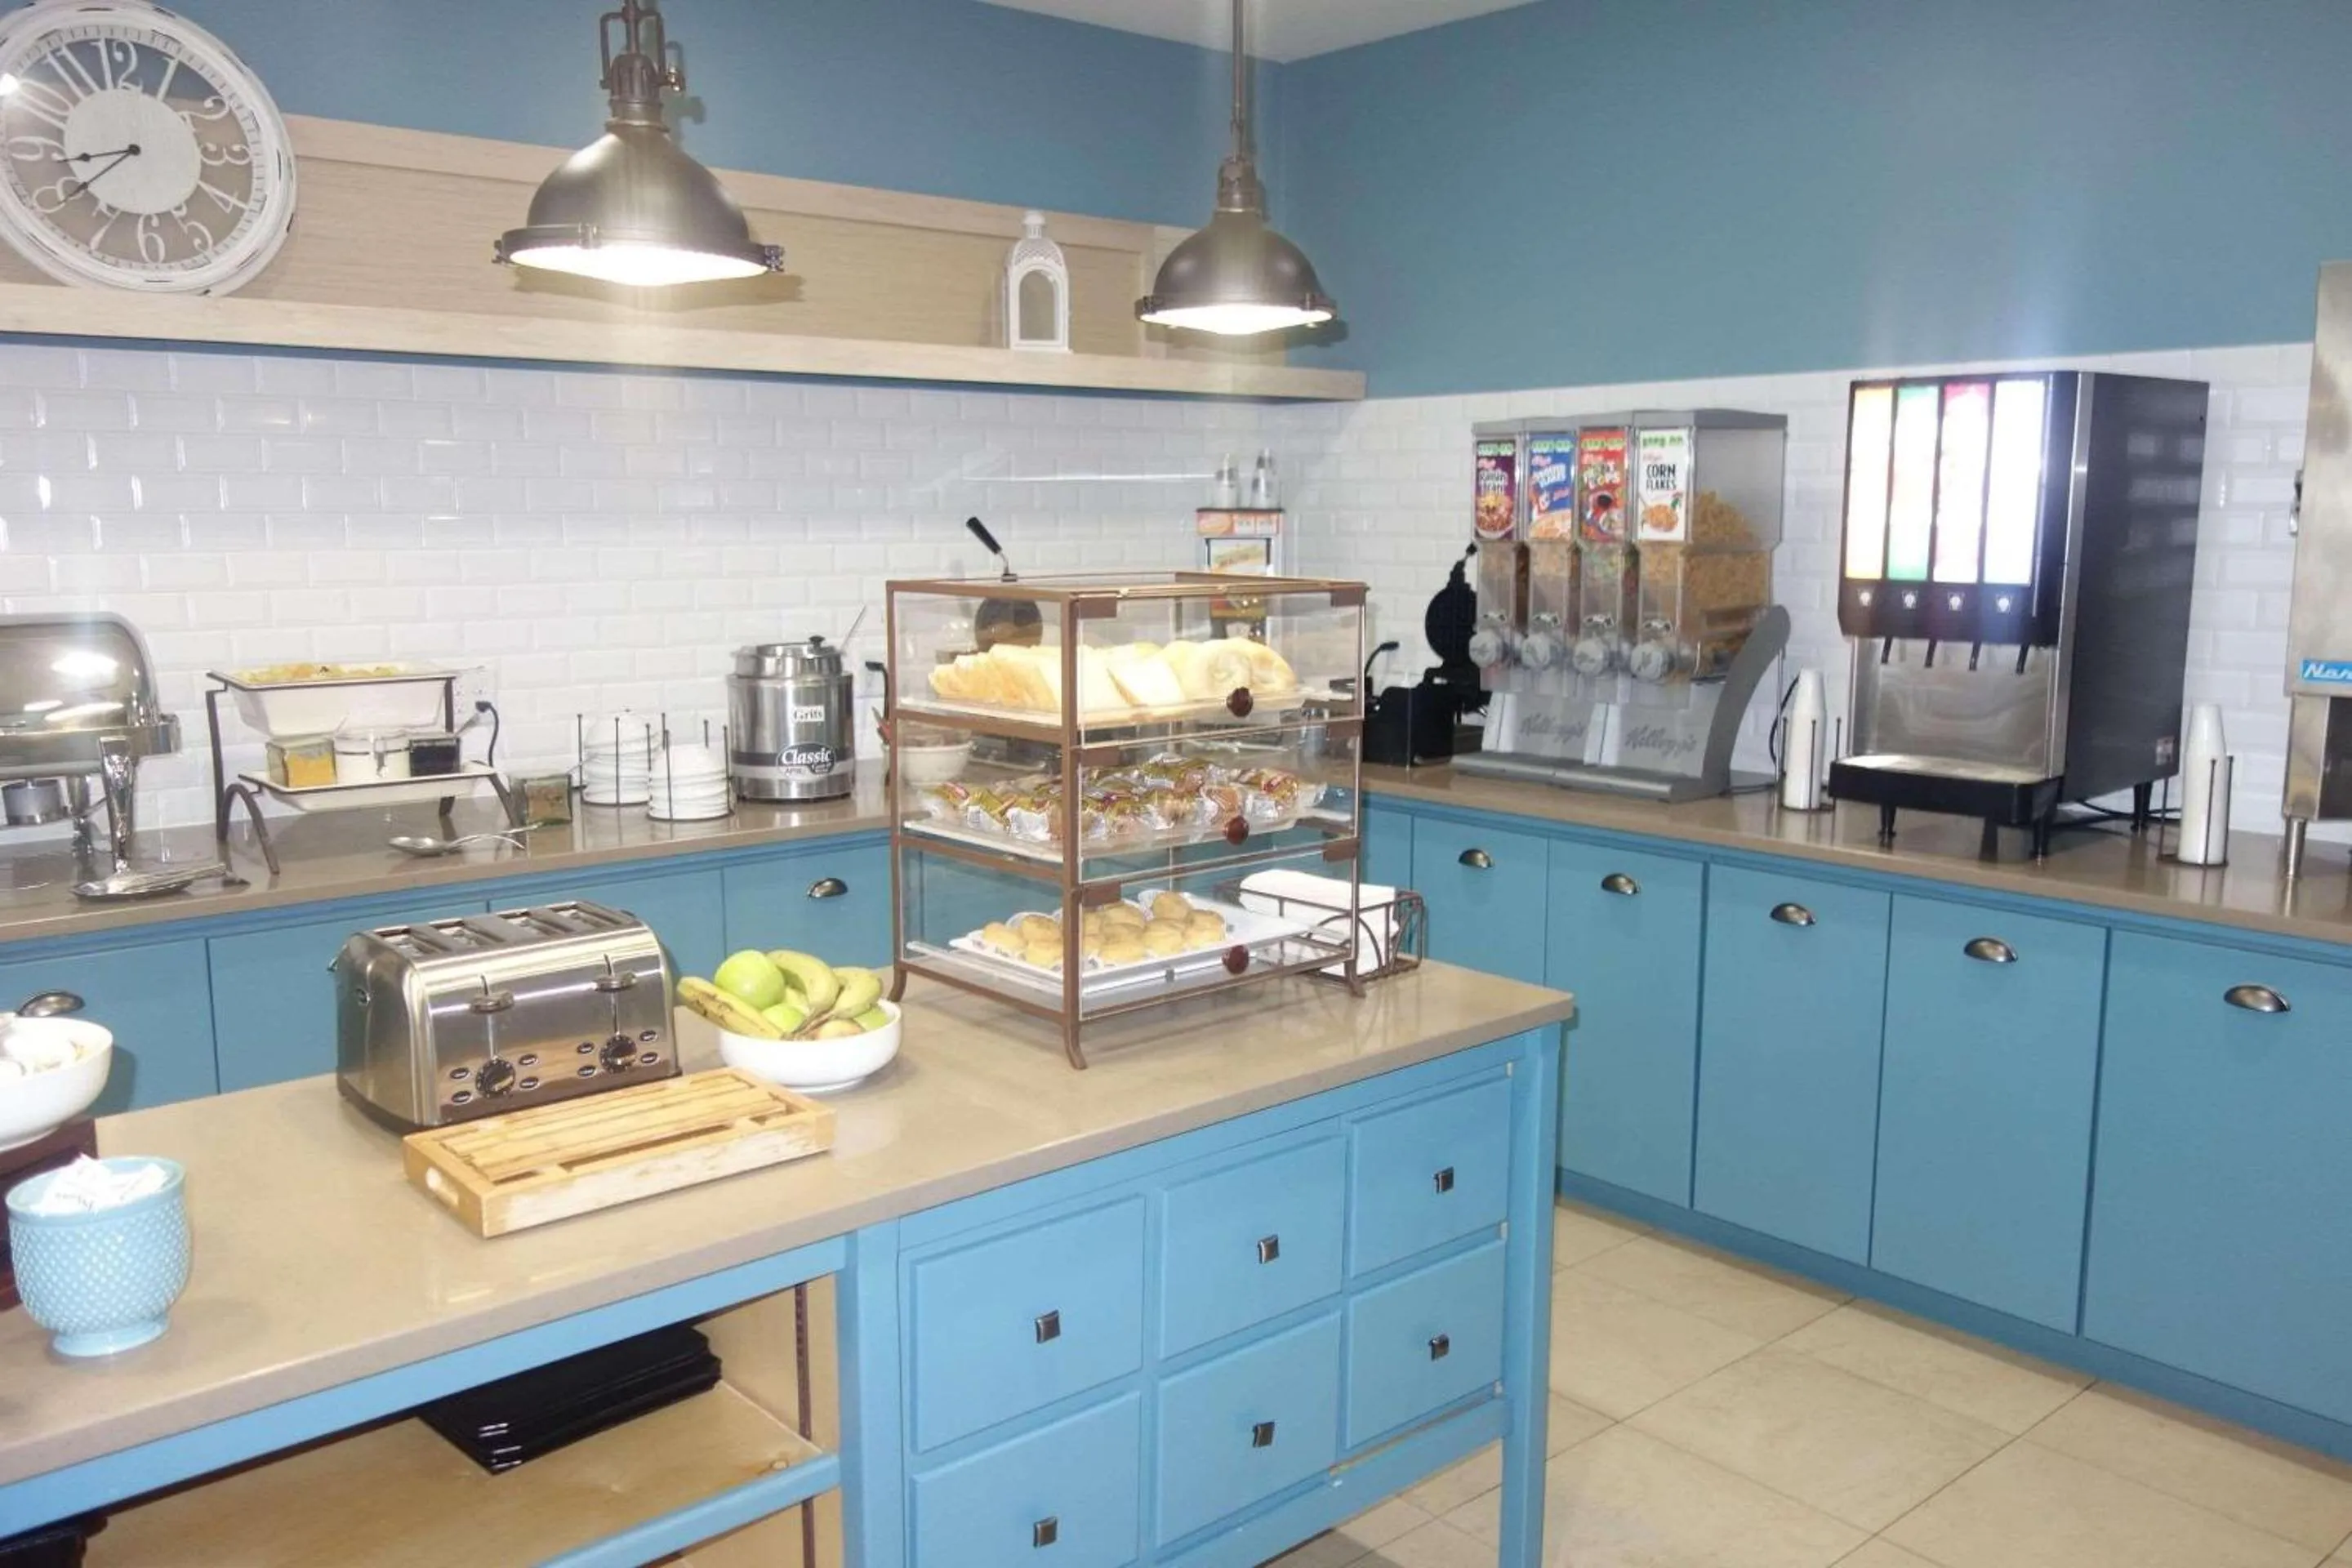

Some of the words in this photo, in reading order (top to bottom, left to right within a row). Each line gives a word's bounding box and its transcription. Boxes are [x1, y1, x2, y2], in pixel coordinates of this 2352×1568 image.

[43, 43, 100, 100] 11
[91, 39, 143, 92] 12
[156, 56, 179, 101] 1
[176, 95, 229, 131] 2
[7, 136, 65, 161] 9
[201, 143, 250, 165] 3
[33, 176, 87, 213] 8
[198, 179, 248, 213] 4
[90, 202, 122, 251] 7
[137, 213, 165, 264] 6
[171, 203, 213, 255] 5
[1646, 463, 1677, 479] CORN
[1646, 479, 1677, 491] FLAKES
[781, 747, 833, 765] Classic
